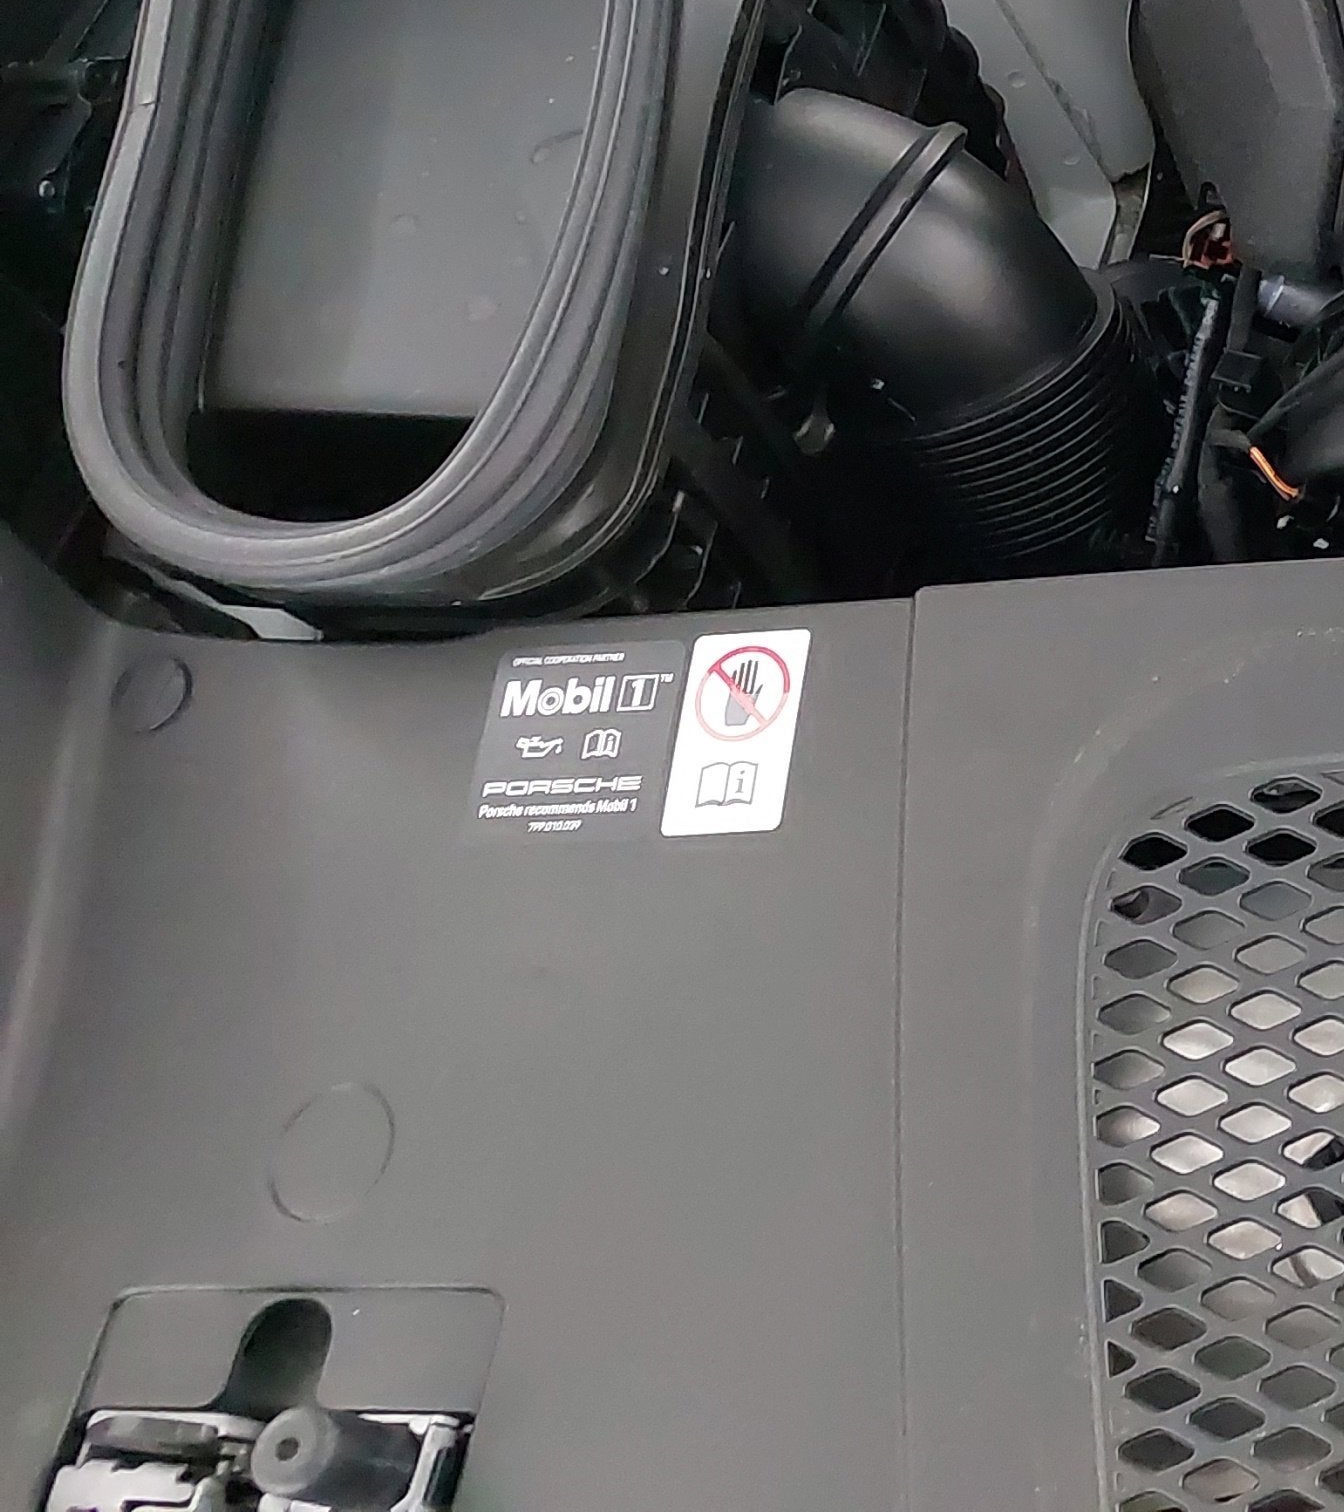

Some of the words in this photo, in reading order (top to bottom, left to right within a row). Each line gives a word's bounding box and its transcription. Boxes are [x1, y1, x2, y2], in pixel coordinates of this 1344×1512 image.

[500, 675, 616, 717] Mobil
[482, 775, 643, 798] PORSCHE
[478, 803, 525, 819] Porsche
[524, 800, 596, 816] recommends
[595, 797, 628, 814] Mobil
